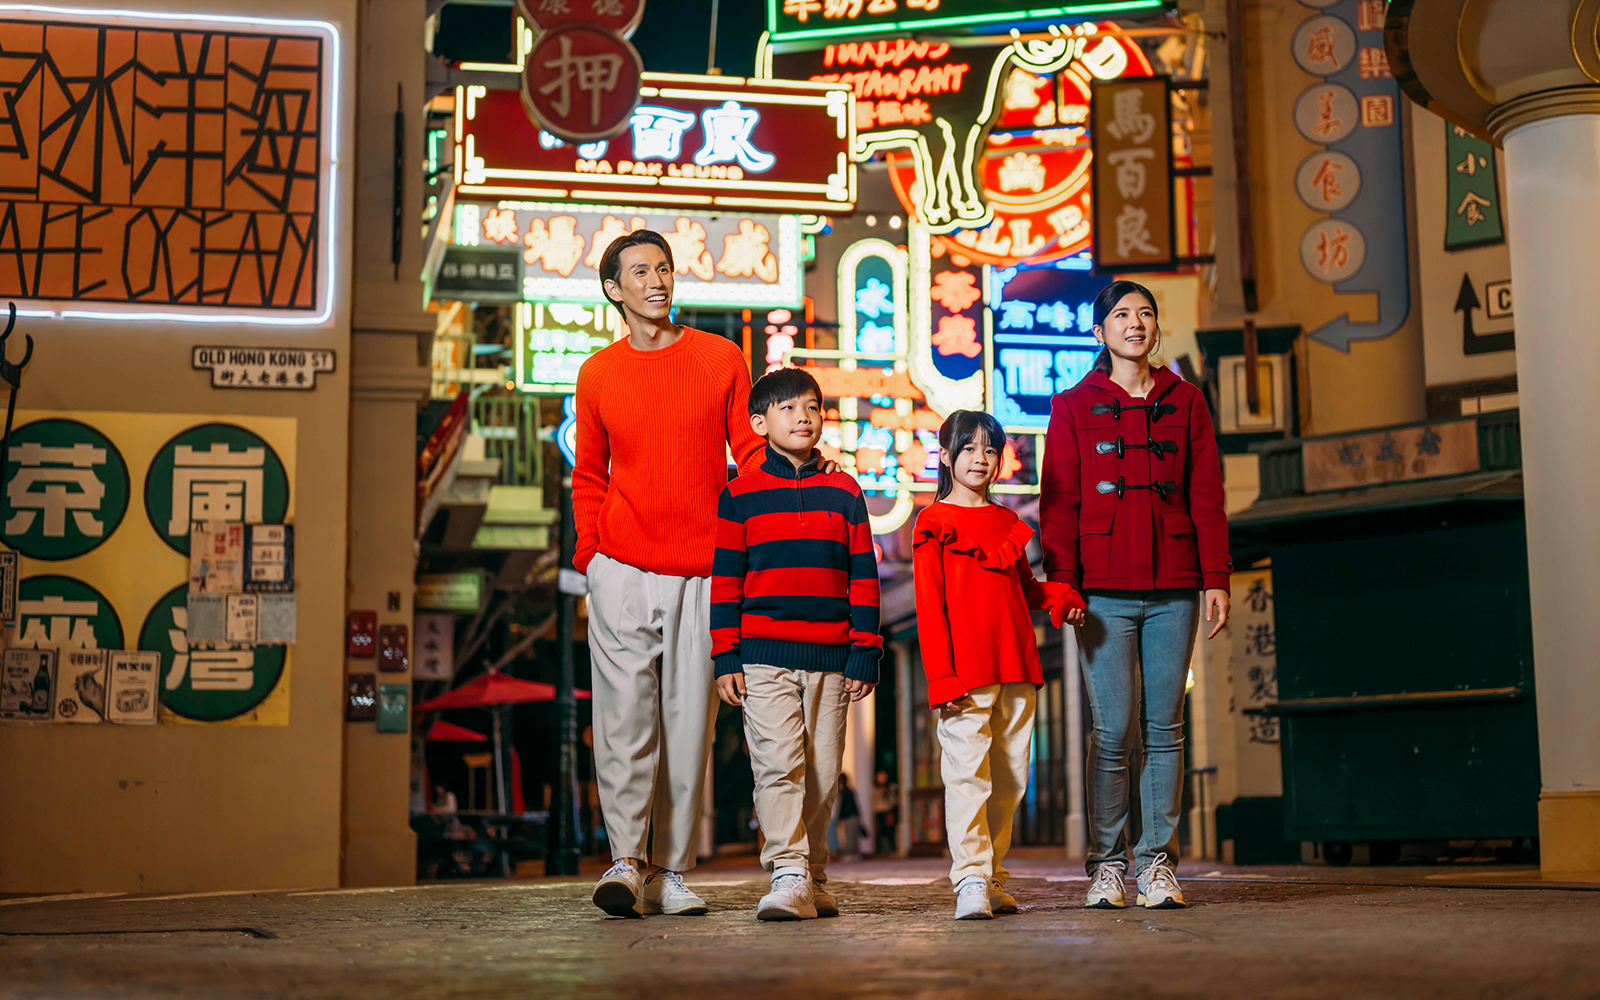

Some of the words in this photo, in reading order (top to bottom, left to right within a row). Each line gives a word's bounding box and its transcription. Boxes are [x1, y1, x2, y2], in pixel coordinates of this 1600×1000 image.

[538, 35, 624, 127] 押
[539, 100, 776, 173] 百良
[575, 158, 613, 175] MA
[617, 160, 663, 177] PAK
[667, 162, 744, 181] LEUNG
[1106, 87, 1160, 259] 馬百良
[122, 206, 318, 309] OCEAN
[200, 351, 225, 366] OLD
[229, 352, 265, 367] HONG
[269, 353, 306, 369] KONG
[311, 352, 327, 368] ST
[1000, 349, 1053, 396] THE
